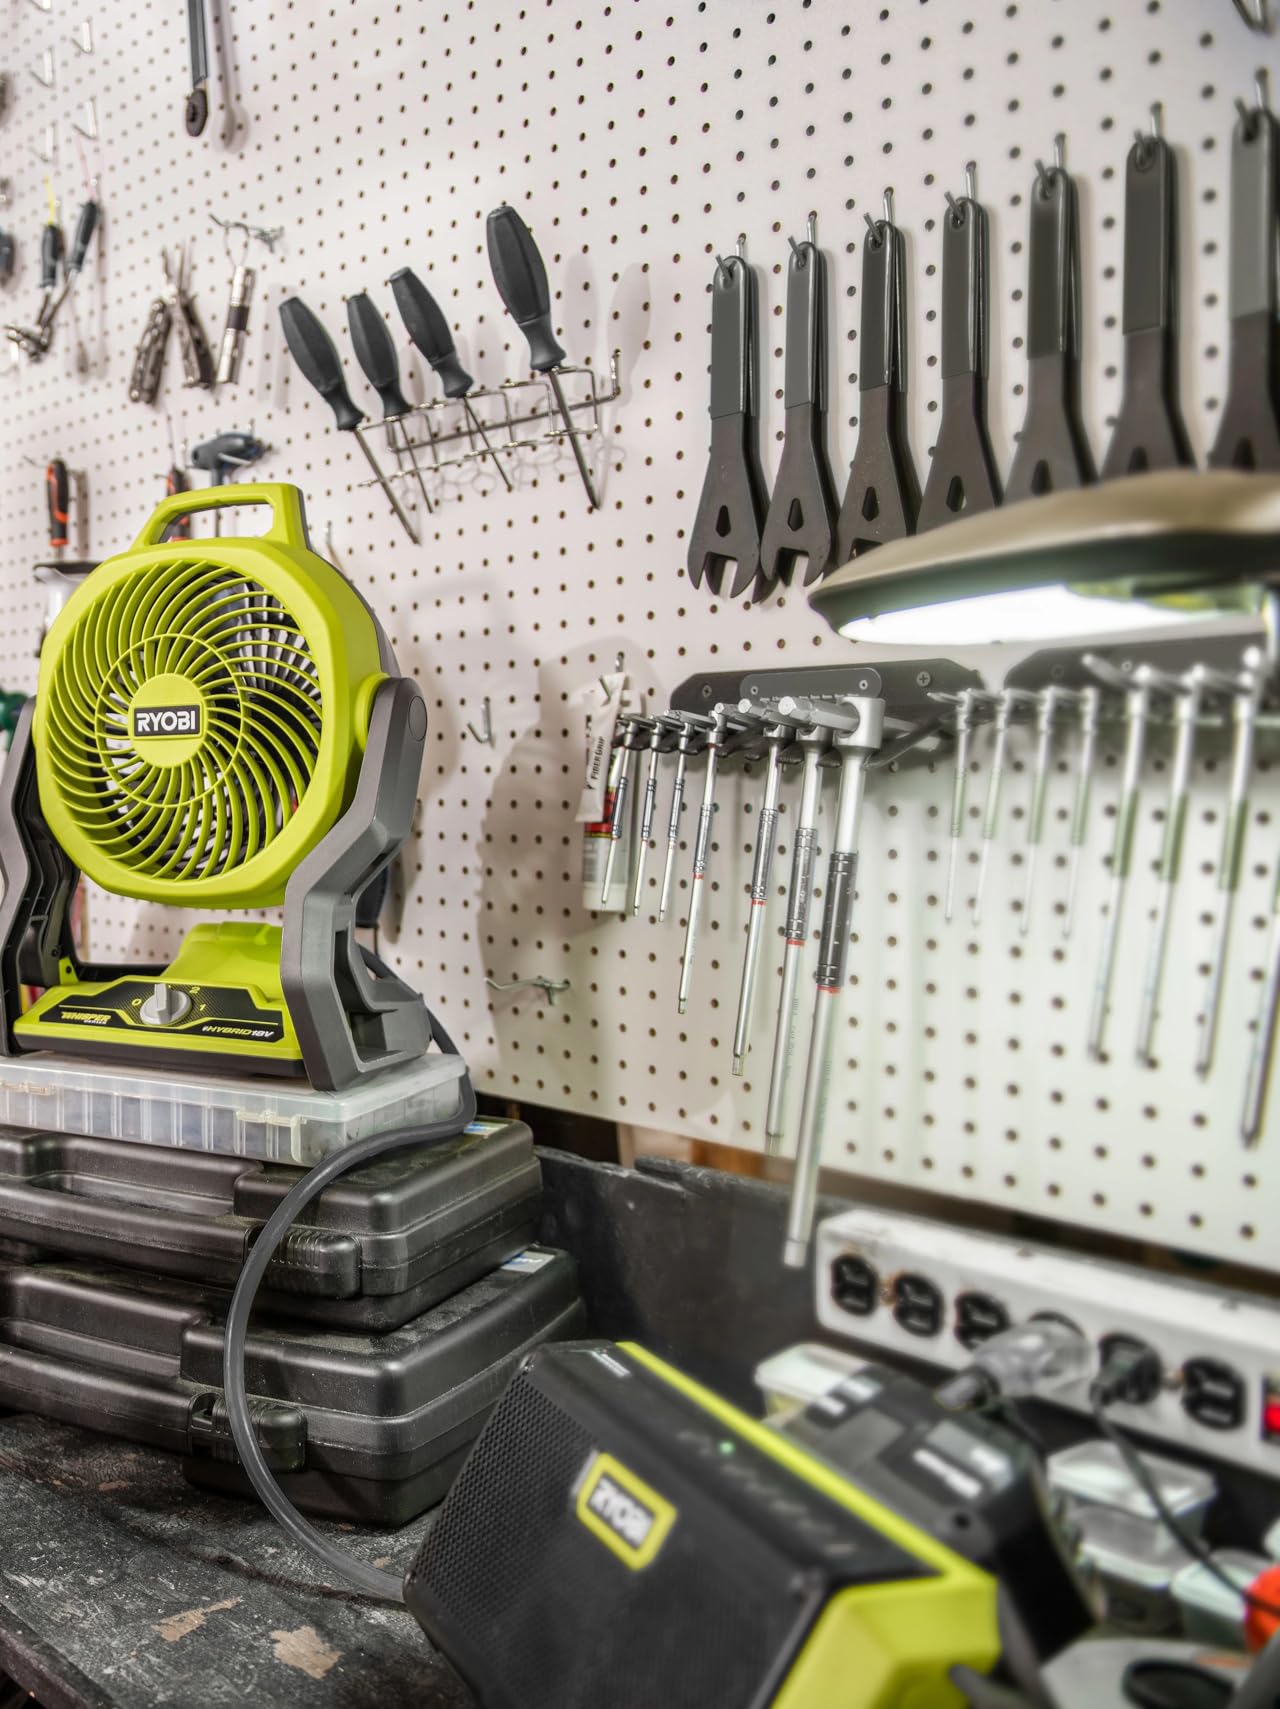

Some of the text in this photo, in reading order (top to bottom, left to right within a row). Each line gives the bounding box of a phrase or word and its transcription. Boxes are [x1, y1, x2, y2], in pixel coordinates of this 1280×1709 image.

[136, 710, 196, 733] RYOBI
[590, 735, 604, 780] FIBER GRIP
[189, 986, 200, 994] 2
[61, 1011, 111, 1022] WHISPER
